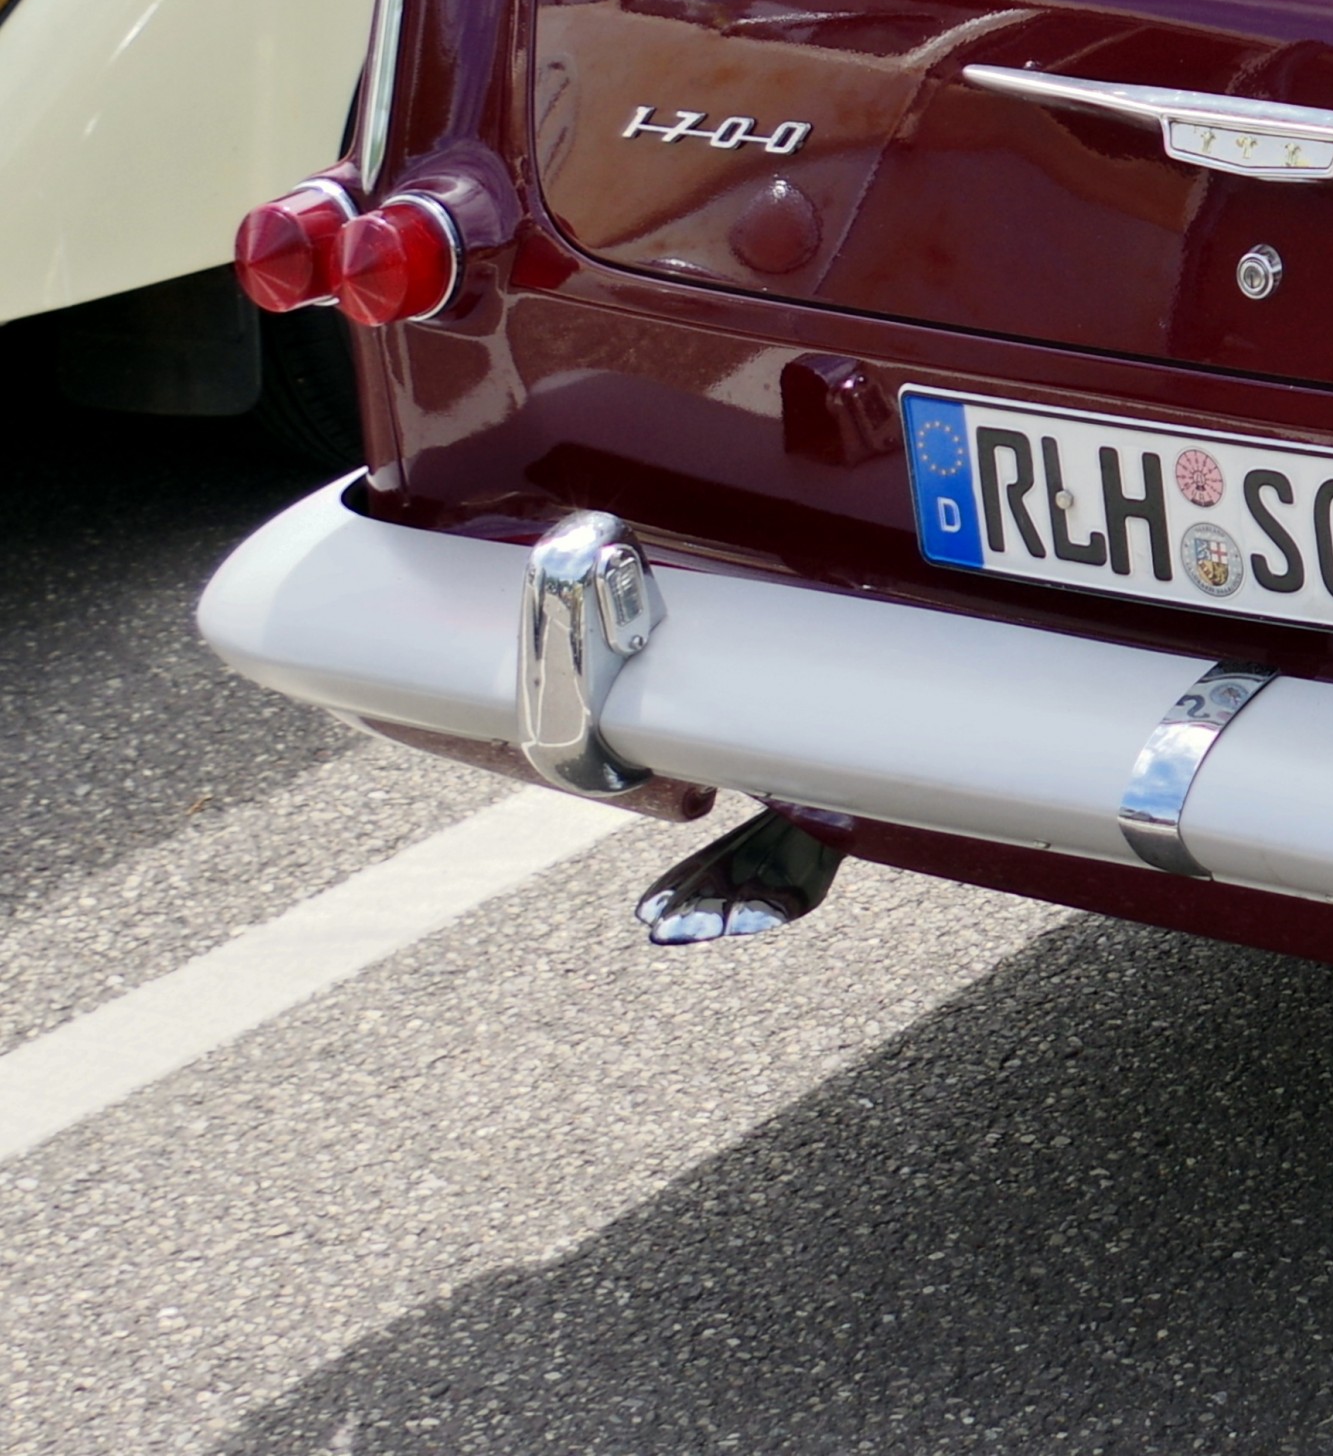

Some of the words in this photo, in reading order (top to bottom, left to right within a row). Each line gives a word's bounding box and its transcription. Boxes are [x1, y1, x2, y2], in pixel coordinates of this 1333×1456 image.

[622, 106, 812, 155] 1700
[937, 496, 962, 534] D
[975, 425, 1173, 582] RLH
